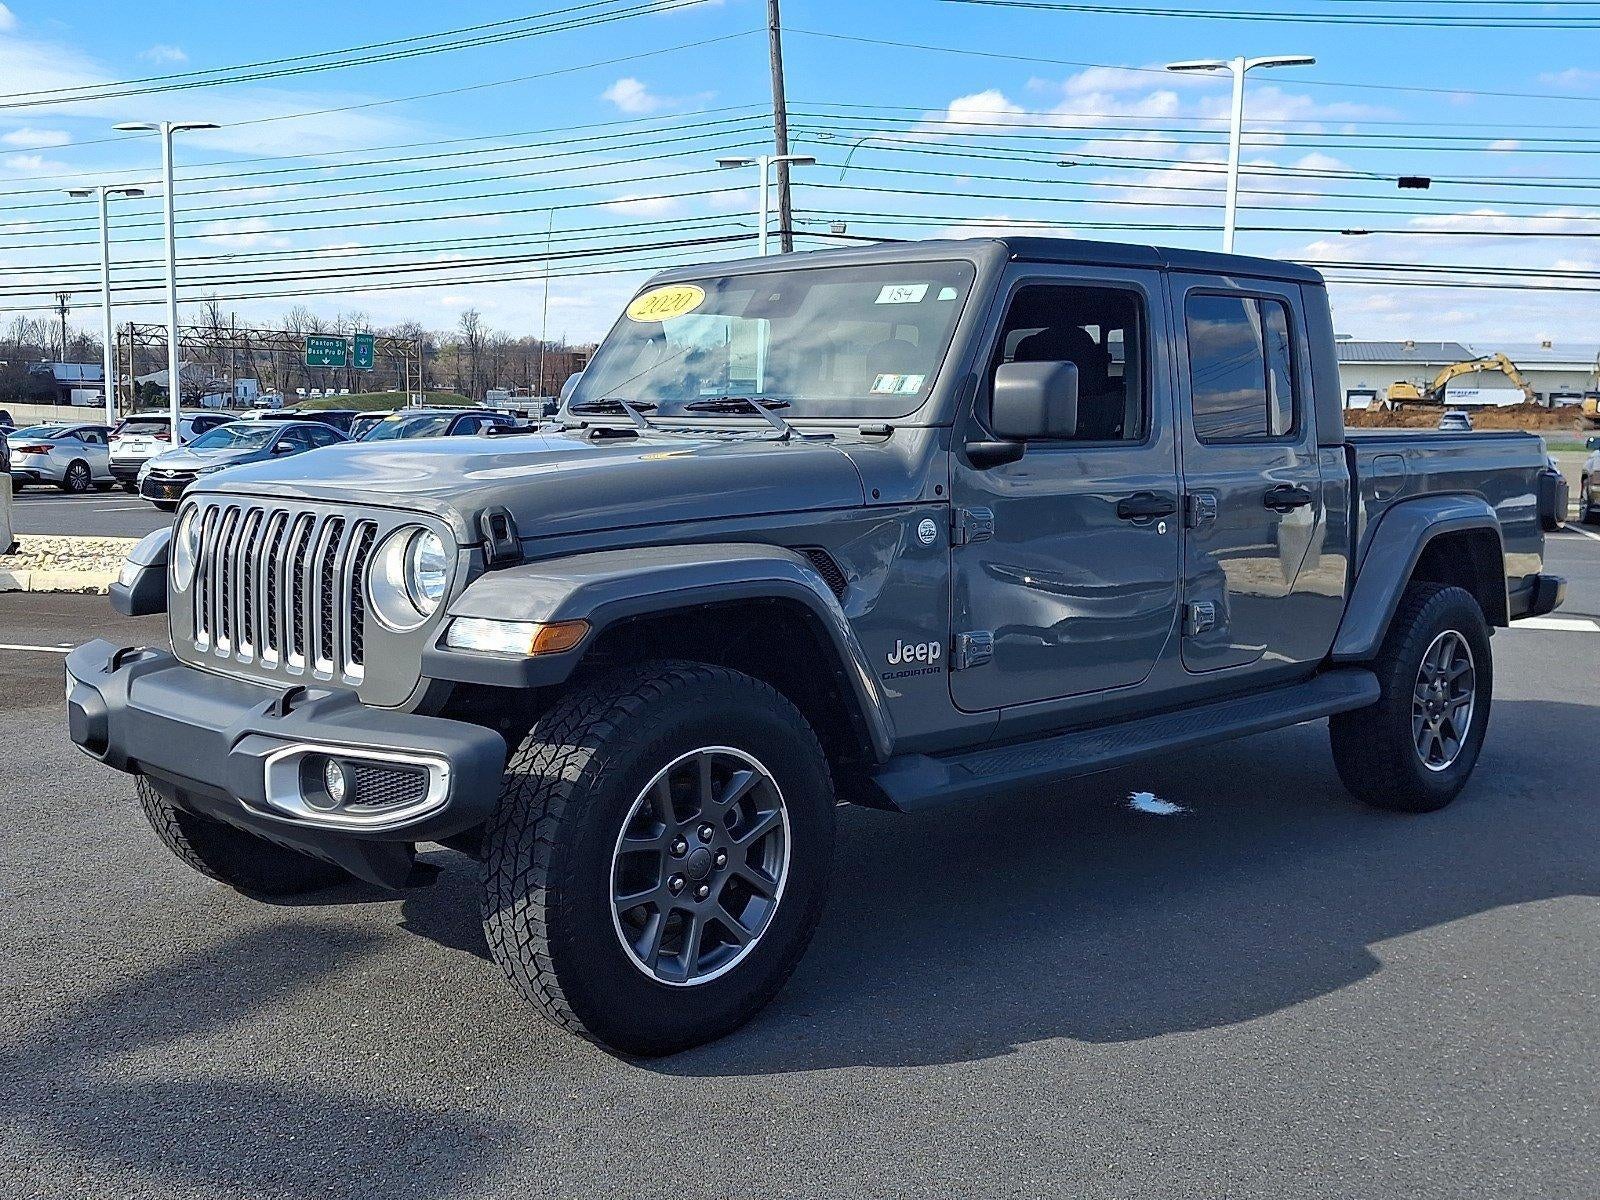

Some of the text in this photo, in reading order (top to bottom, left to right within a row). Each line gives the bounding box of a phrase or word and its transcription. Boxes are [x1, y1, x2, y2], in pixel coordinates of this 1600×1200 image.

[636, 292, 693, 315] 2020
[887, 639, 941, 665] Jeep
[881, 666, 941, 680] GLADIATOR
